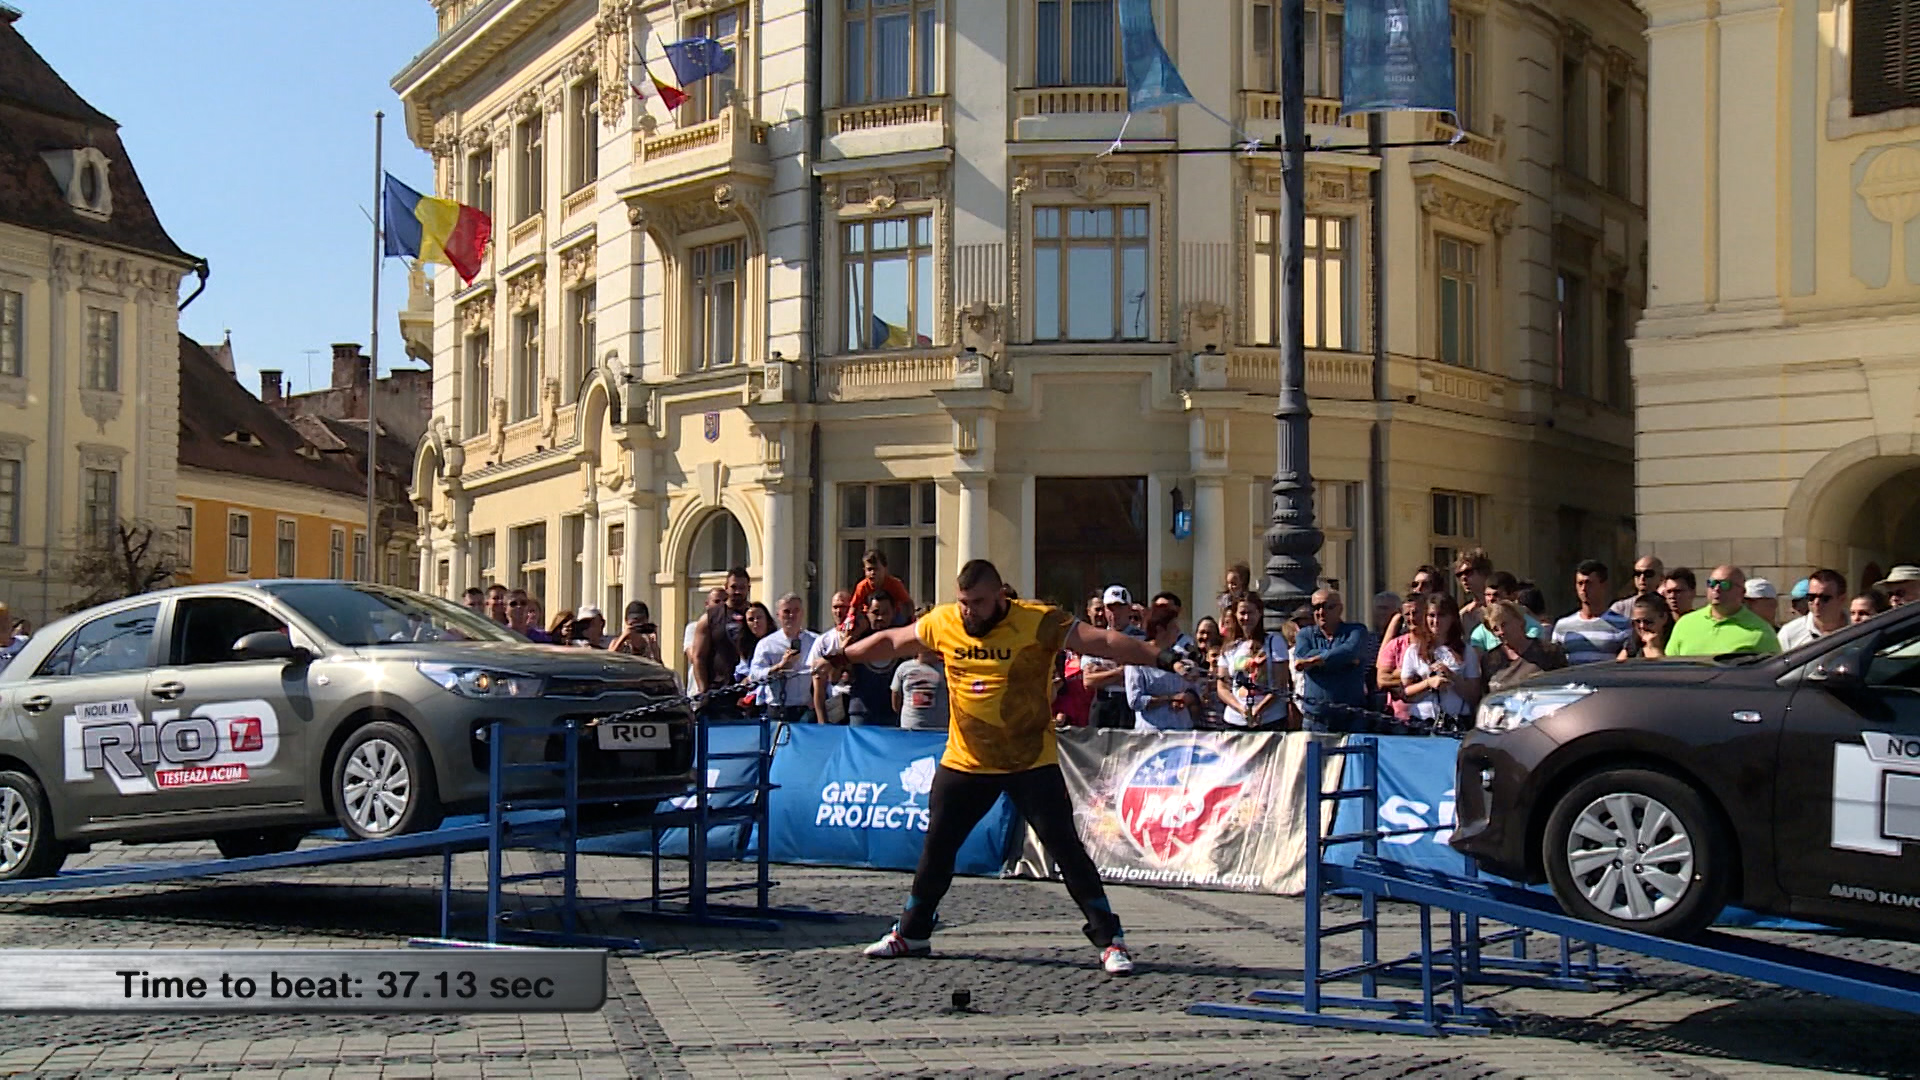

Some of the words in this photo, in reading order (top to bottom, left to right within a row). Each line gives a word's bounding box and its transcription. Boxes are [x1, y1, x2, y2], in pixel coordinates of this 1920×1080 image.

[111, 703, 129, 714] KIA
[82, 718, 219, 779] RIO
[210, 767, 242, 780] ACUM
[822, 781, 888, 804] GREY
[815, 803, 930, 832] PROJECTS
[1829, 883, 1877, 902] AUTO
